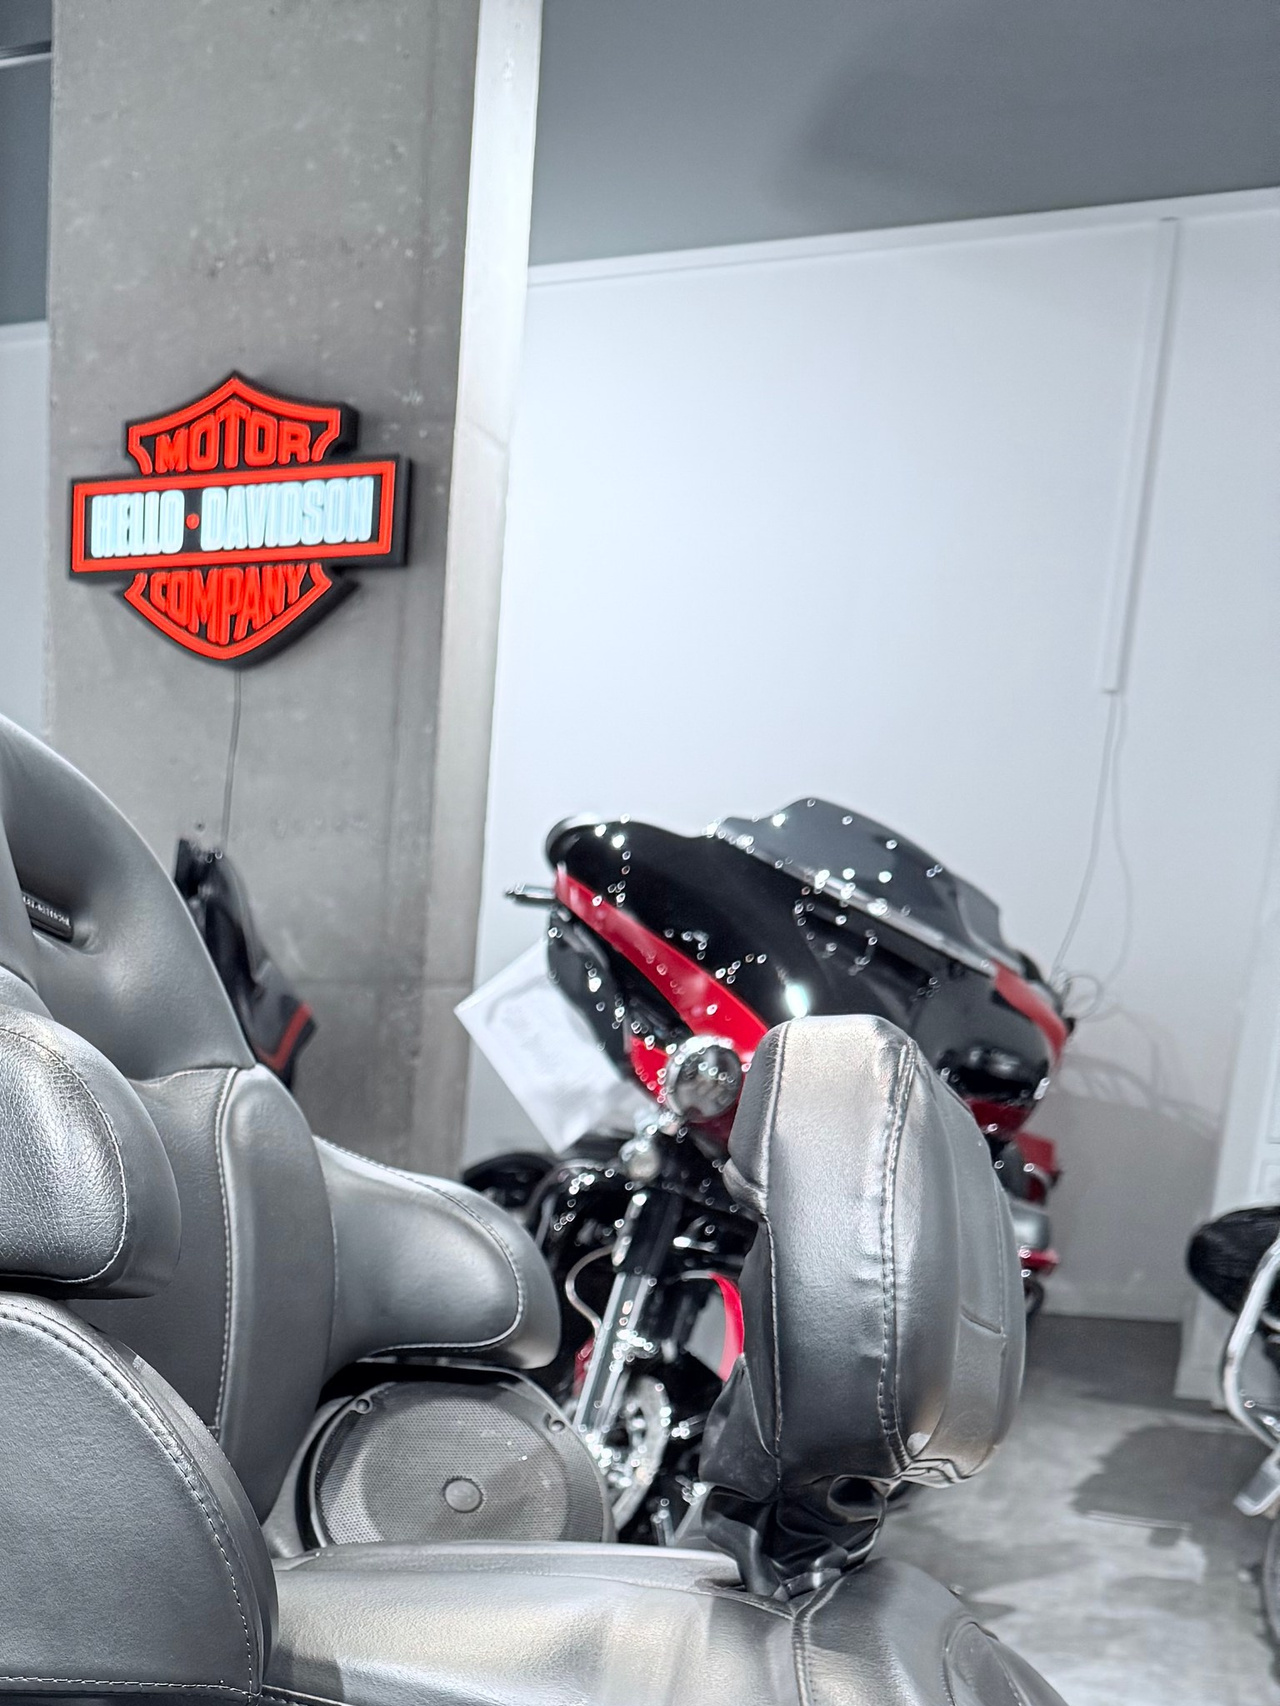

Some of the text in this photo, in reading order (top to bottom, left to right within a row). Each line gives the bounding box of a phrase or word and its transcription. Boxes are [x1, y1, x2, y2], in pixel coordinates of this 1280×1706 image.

[154, 399, 311, 474] MOTOR
[200, 475, 375, 552] DAVIDSON
[149, 562, 308, 646] COMPANY
